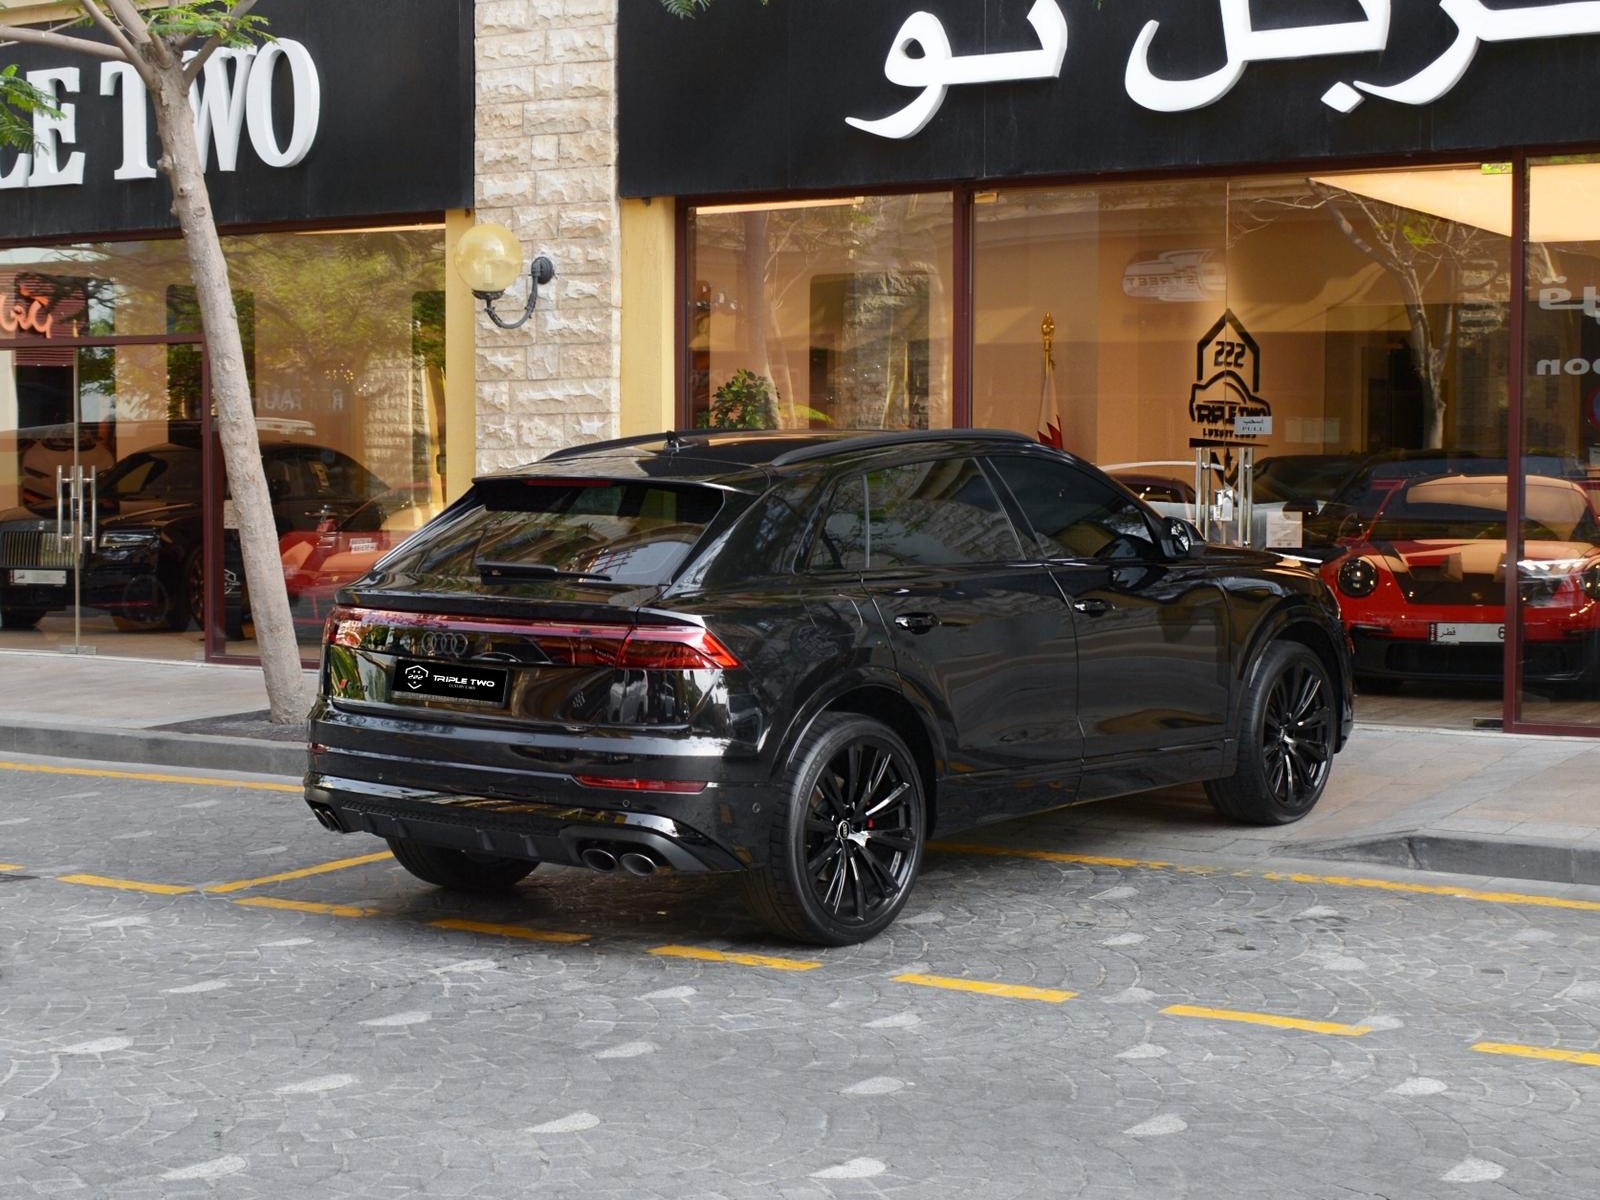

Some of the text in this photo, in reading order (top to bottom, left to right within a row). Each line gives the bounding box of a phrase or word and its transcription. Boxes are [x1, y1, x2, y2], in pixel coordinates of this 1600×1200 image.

[100, 37, 320, 181] TWO
[1214, 341, 1246, 368] 222
[433, 675, 495, 687] TRIPLE TWO
